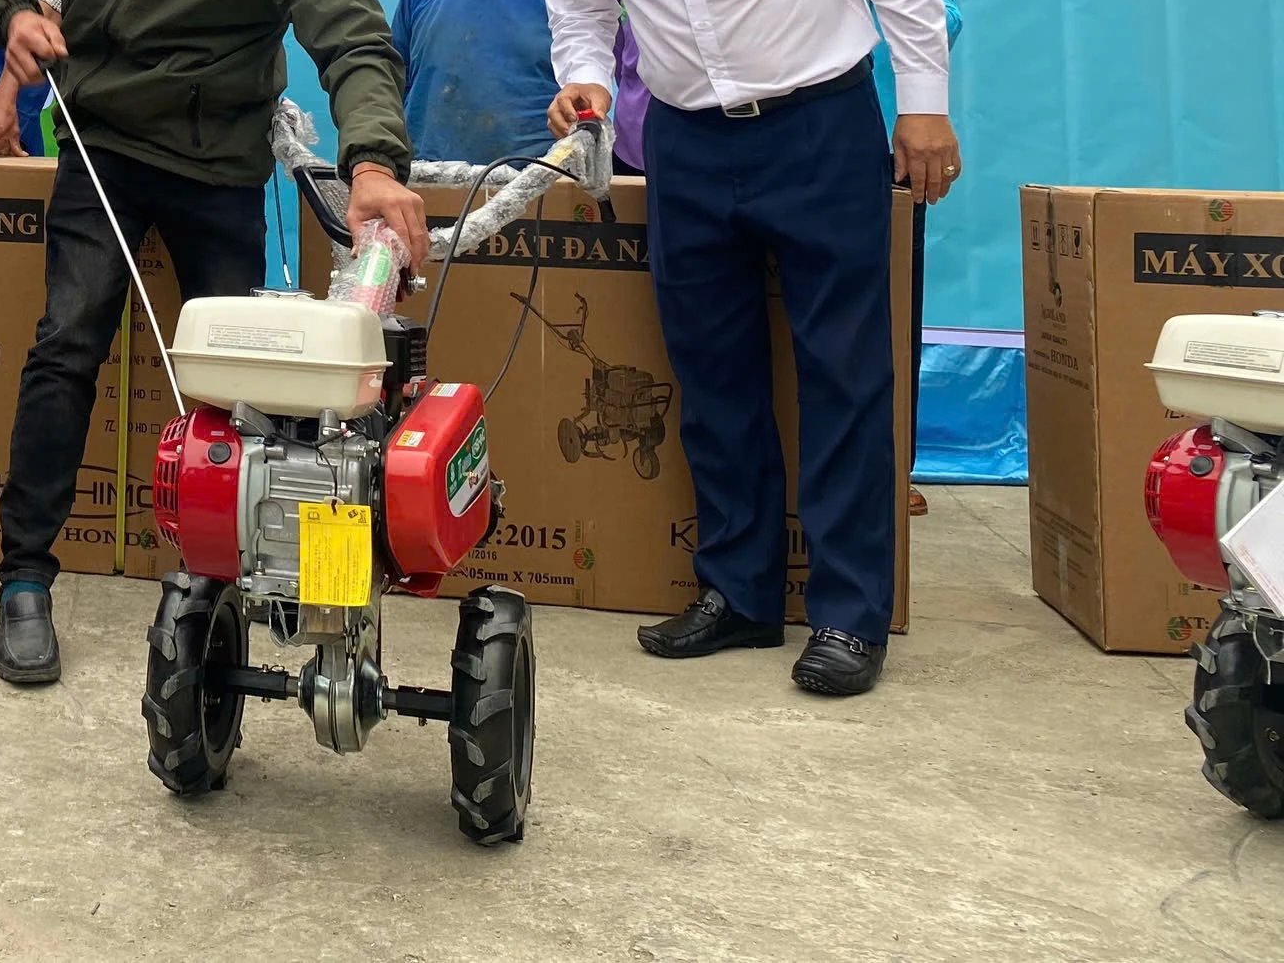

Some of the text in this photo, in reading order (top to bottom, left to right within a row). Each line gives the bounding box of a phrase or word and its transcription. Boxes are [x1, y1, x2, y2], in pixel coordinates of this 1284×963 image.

[487, 227, 555, 259] ĐẤT
[562, 236, 611, 261] ĐA
[1141, 243, 1235, 277] MÁY
[512, 571, 524, 583] X
[528, 572, 575, 585] 705mm
